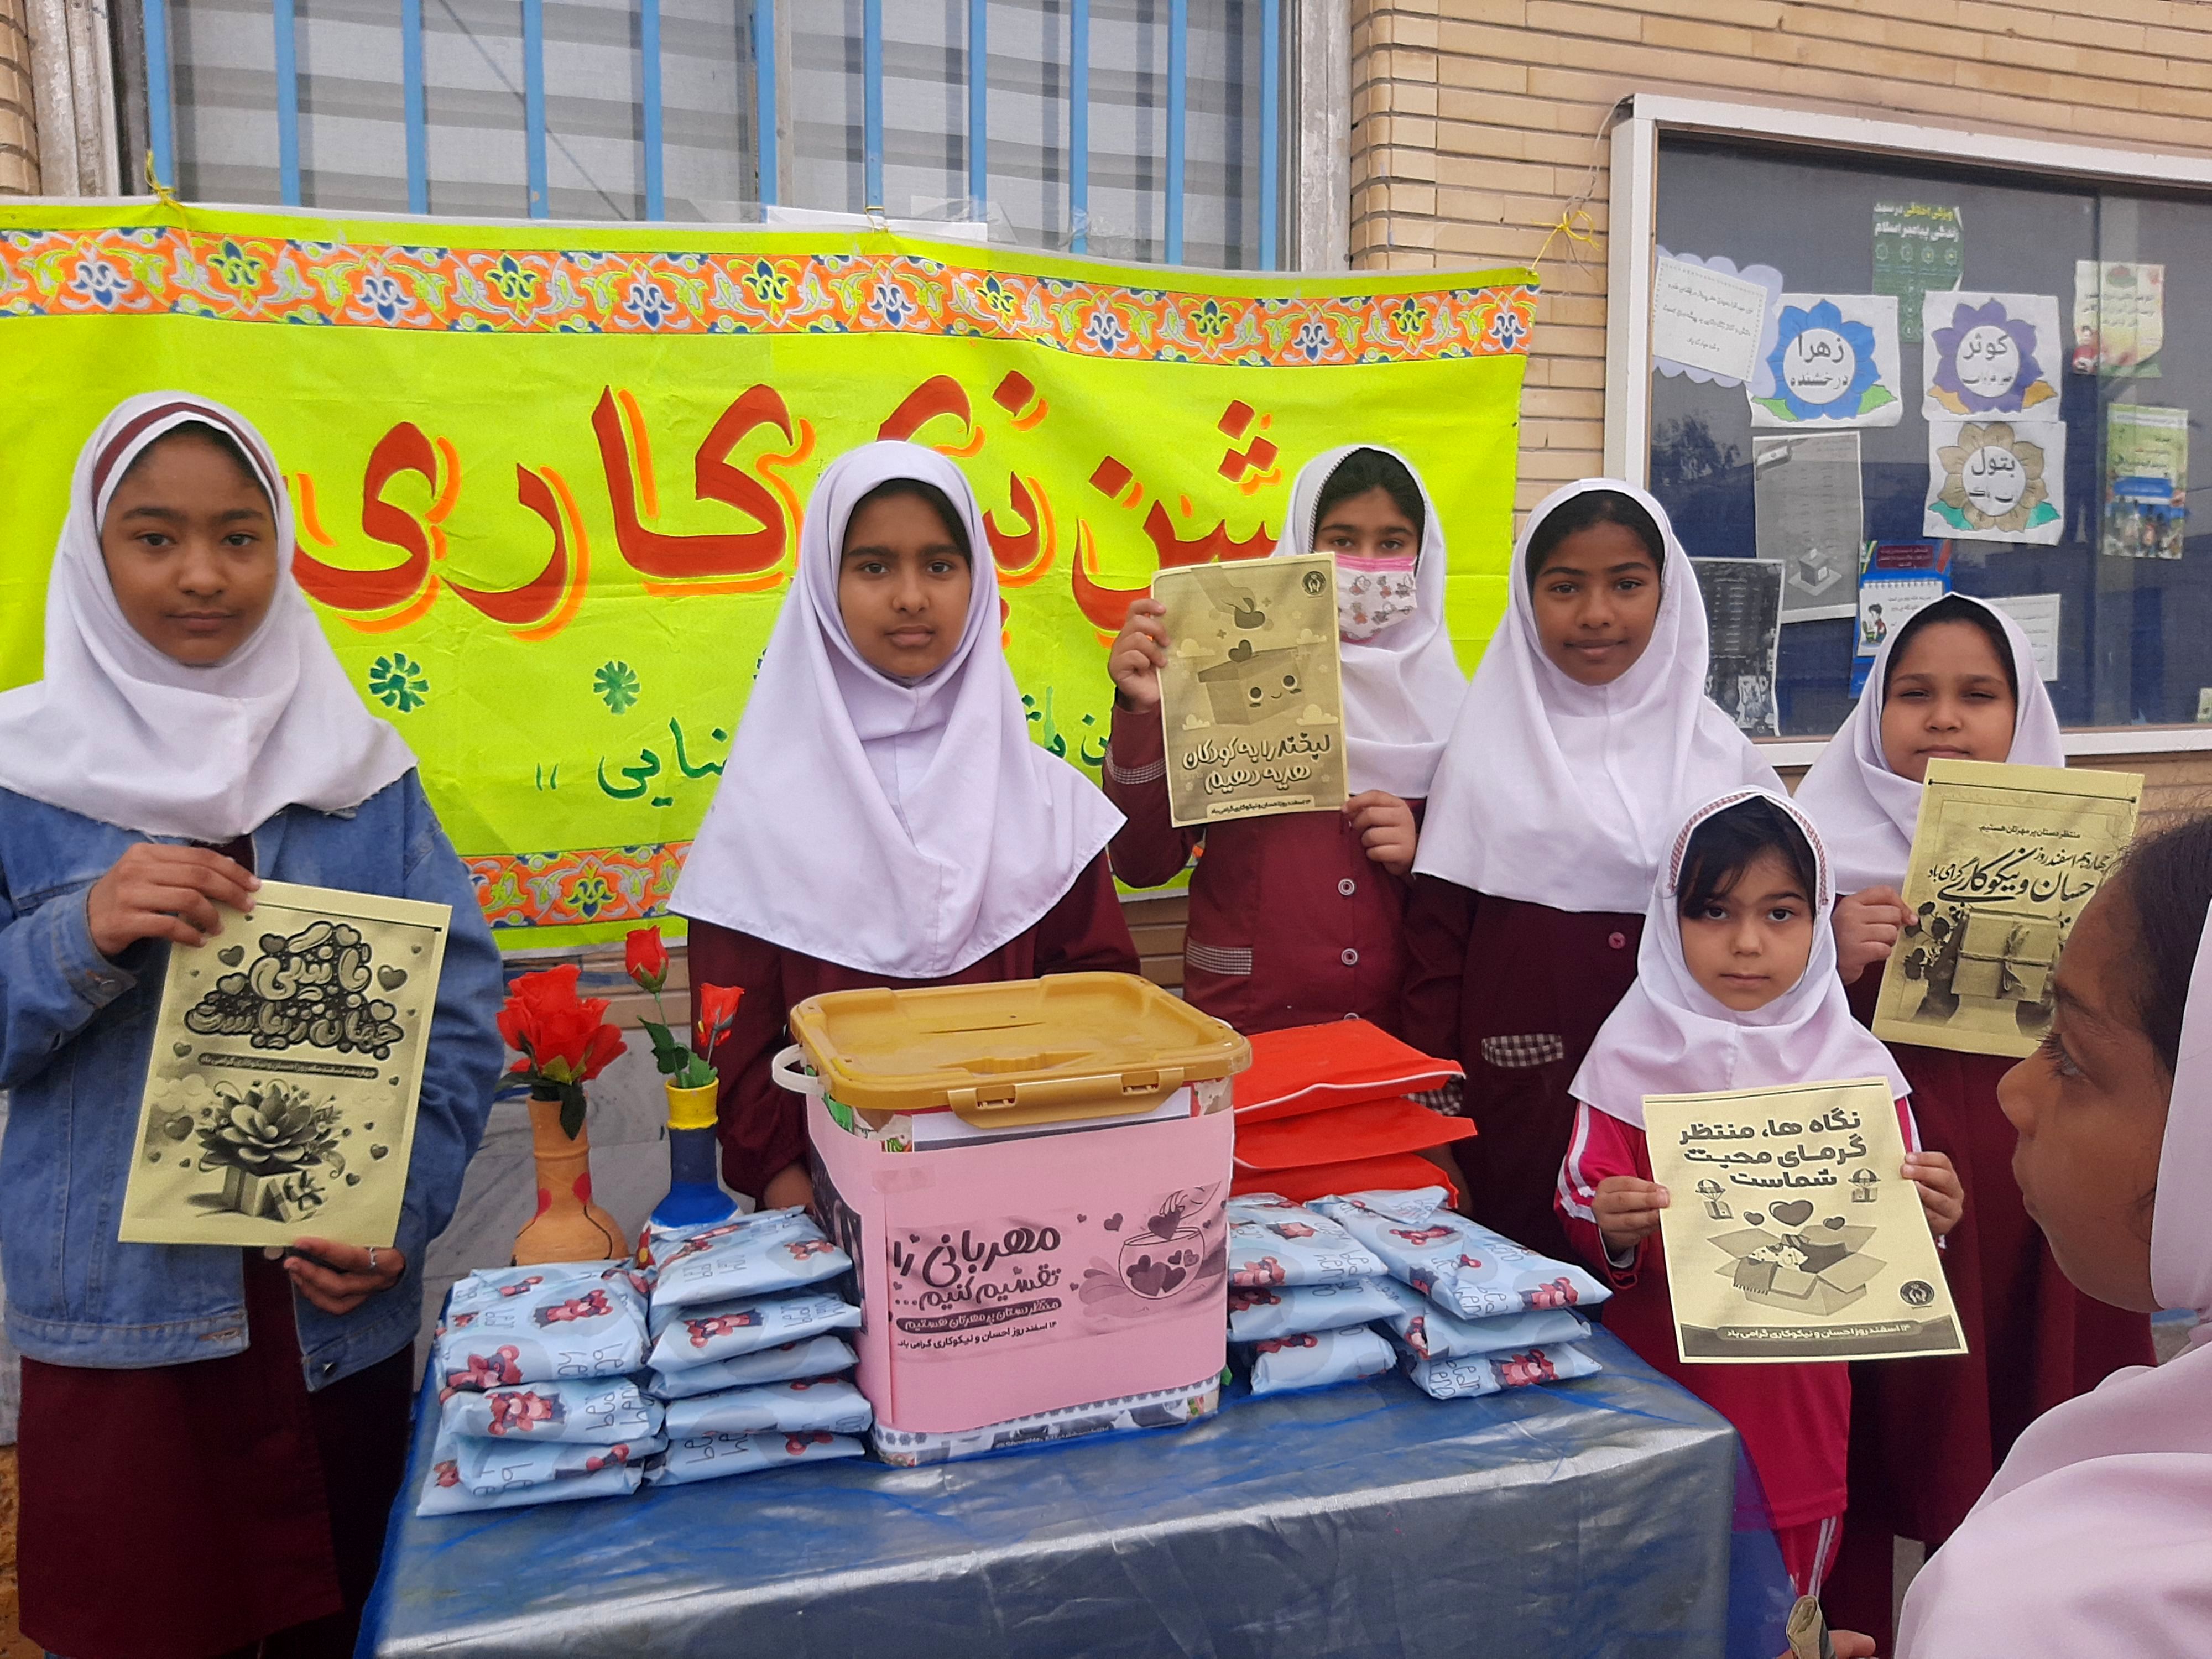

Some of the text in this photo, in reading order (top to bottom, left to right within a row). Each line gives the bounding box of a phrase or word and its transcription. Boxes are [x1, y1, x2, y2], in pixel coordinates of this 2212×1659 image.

[1798, 334, 1844, 363] زهرا
[1963, 333, 2008, 361] کوثر
[1791, 372, 1848, 389] درخشنده
[1971, 447, 2015, 478] بتول
[1072, 399, 1279, 630] شن
[1182, 733, 1330, 769] لبخند را به کودکان
[1204, 765, 1311, 795] هدیه دهیم
[2037, 828, 2059, 837] دستان
[2058, 830, 2080, 839] منتظر
[2033, 847, 2048, 864] روز
[2045, 849, 2077, 868] اسفند
[1937, 847, 2038, 902] نیکوکاری
[2016, 879, 2028, 895] و
[1679, 1107, 1860, 1145] نگاه ها، منتظر
[1684, 1133, 1867, 1168] گرمای محبت
[1730, 1168, 1837, 1188] شماست
[894, 1227, 1061, 1288] مهربانی را
[976, 1263, 1062, 1304] تقسیم
[996, 1306, 1028, 1321] دستان
[1028, 1300, 1059, 1316] منتظر
[905, 1319, 948, 1332] هستیم
[949, 1314, 986, 1328] مهرتان
[1025, 1323, 1048, 1333] اسفند
[982, 1328, 1010, 1342] احسان
[1012, 1327, 1024, 1337] روز
[1727, 1329, 1740, 1338] باد
[1740, 1328, 1768, 1339] گرامی
[1770, 1329, 1813, 1339] نیکوکاری
[1821, 1328, 1854, 1338] احسان
[1855, 1328, 1869, 1337] روز
[1869, 1325, 1900, 1333] اسفند
[910, 1339, 932, 1349] گرامی
[933, 1334, 973, 1349] نیکوکاری
[975, 1335, 980, 1344] و
